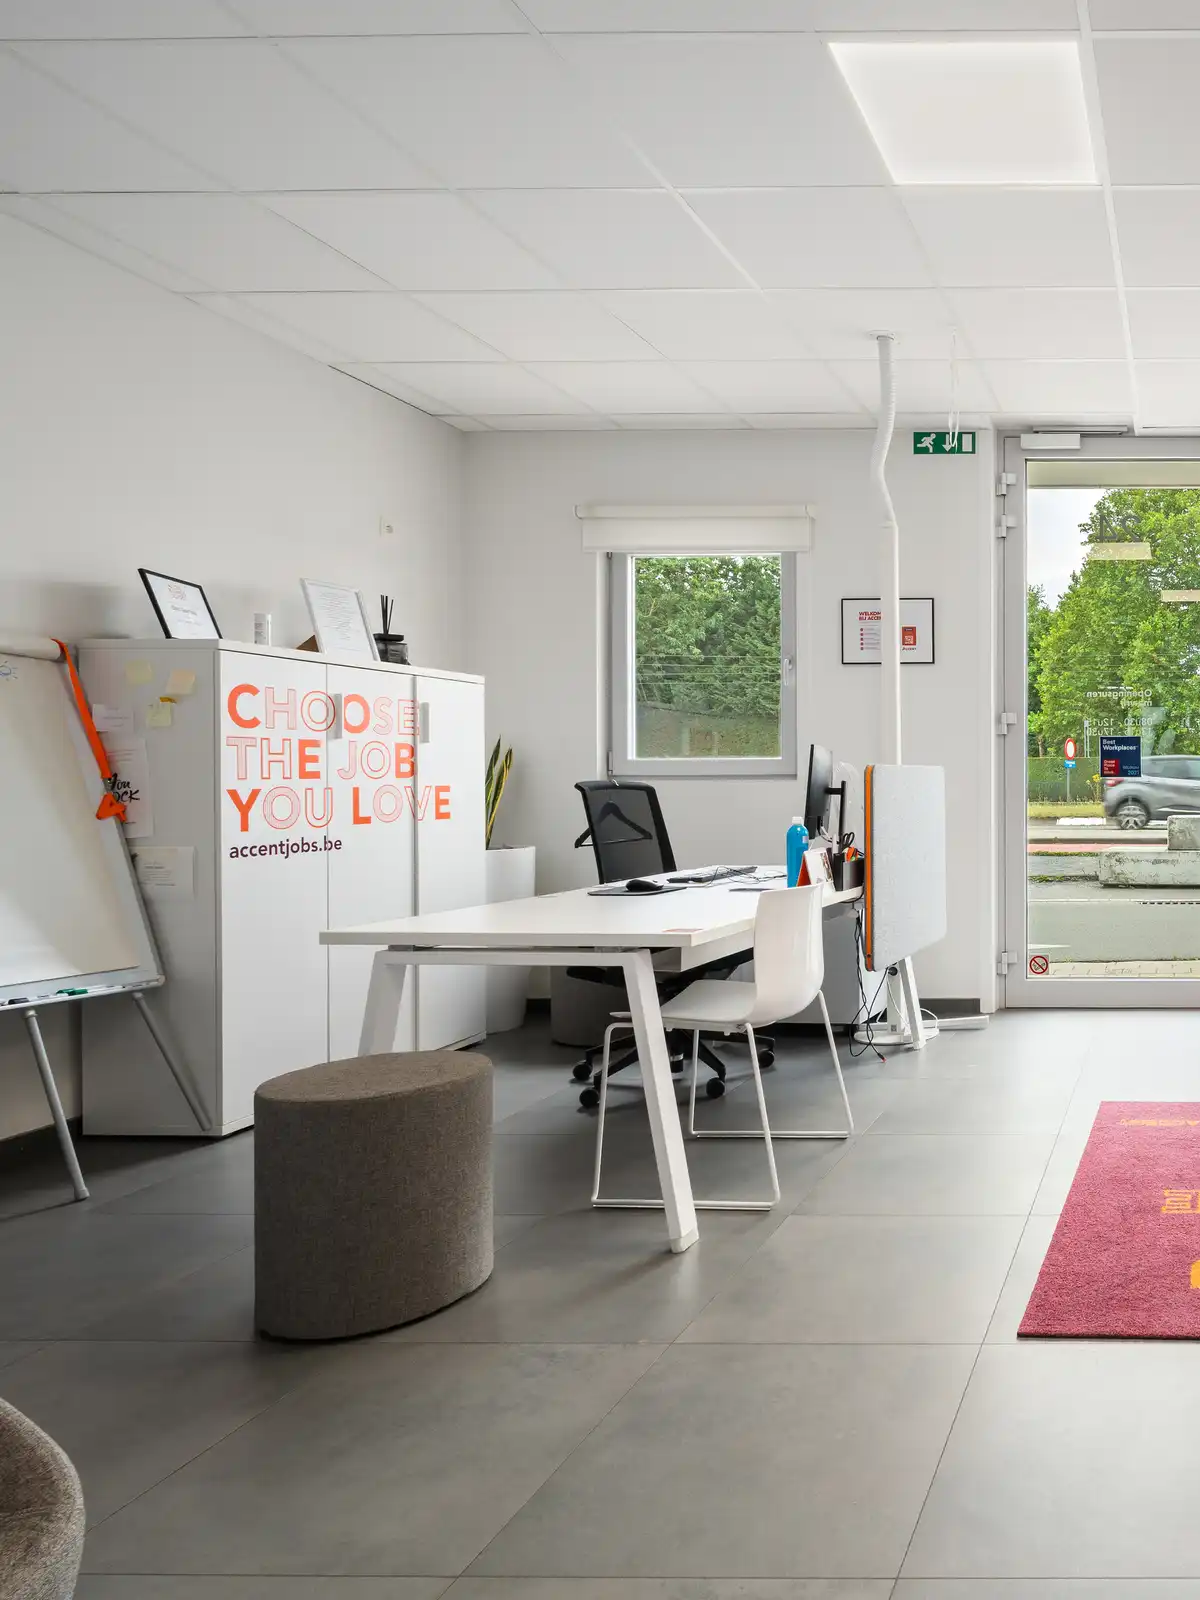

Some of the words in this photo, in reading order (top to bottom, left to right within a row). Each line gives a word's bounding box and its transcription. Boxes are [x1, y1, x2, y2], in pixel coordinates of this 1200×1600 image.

[227, 683, 420, 736] CHOOSE
[226, 736, 322, 780] THE
[337, 741, 416, 780] JOB
[113, 789, 140, 803] OCK
[226, 786, 334, 832] YOU
[352, 784, 451, 825] LOVE
[229, 835, 343, 859] accentjobs.be
